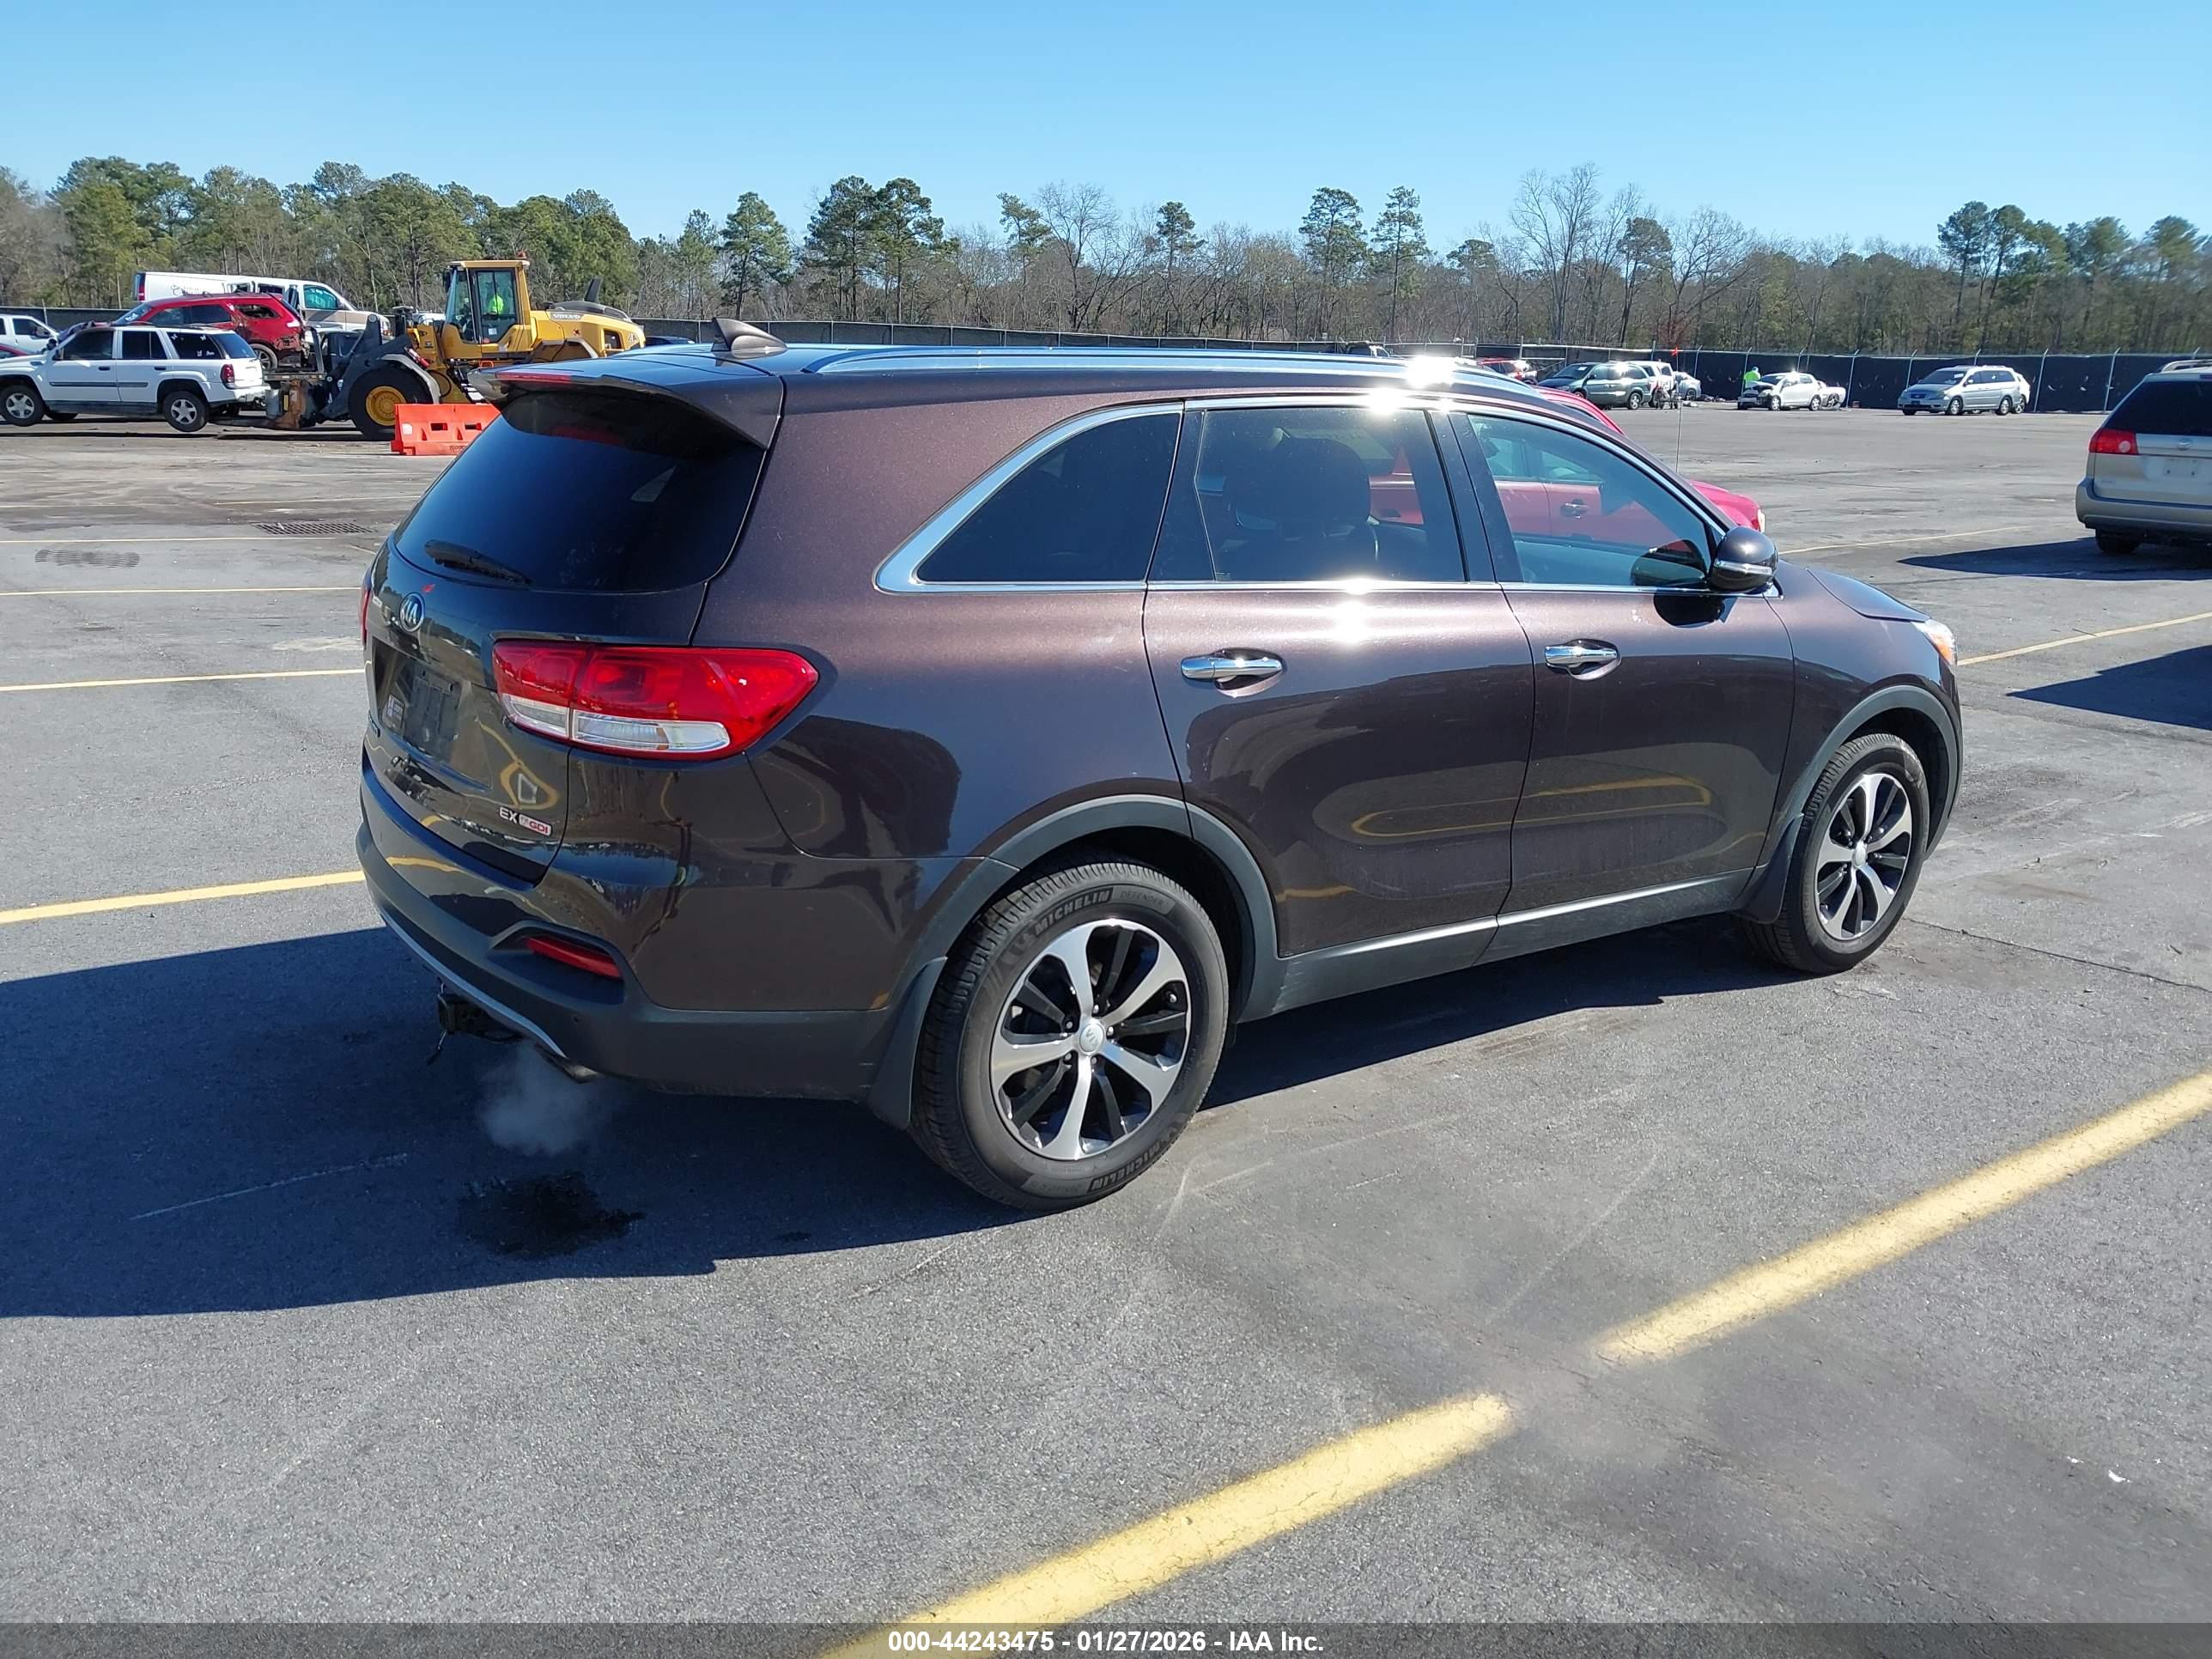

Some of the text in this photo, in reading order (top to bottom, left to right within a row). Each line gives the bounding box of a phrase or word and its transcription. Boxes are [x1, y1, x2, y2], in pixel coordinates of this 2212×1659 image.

[500, 806, 518, 823] EX
[529, 821, 549, 834] GDI
[1034, 889, 1112, 936] MICHELIN
[1089, 1140, 1164, 1192] MICHELIN
